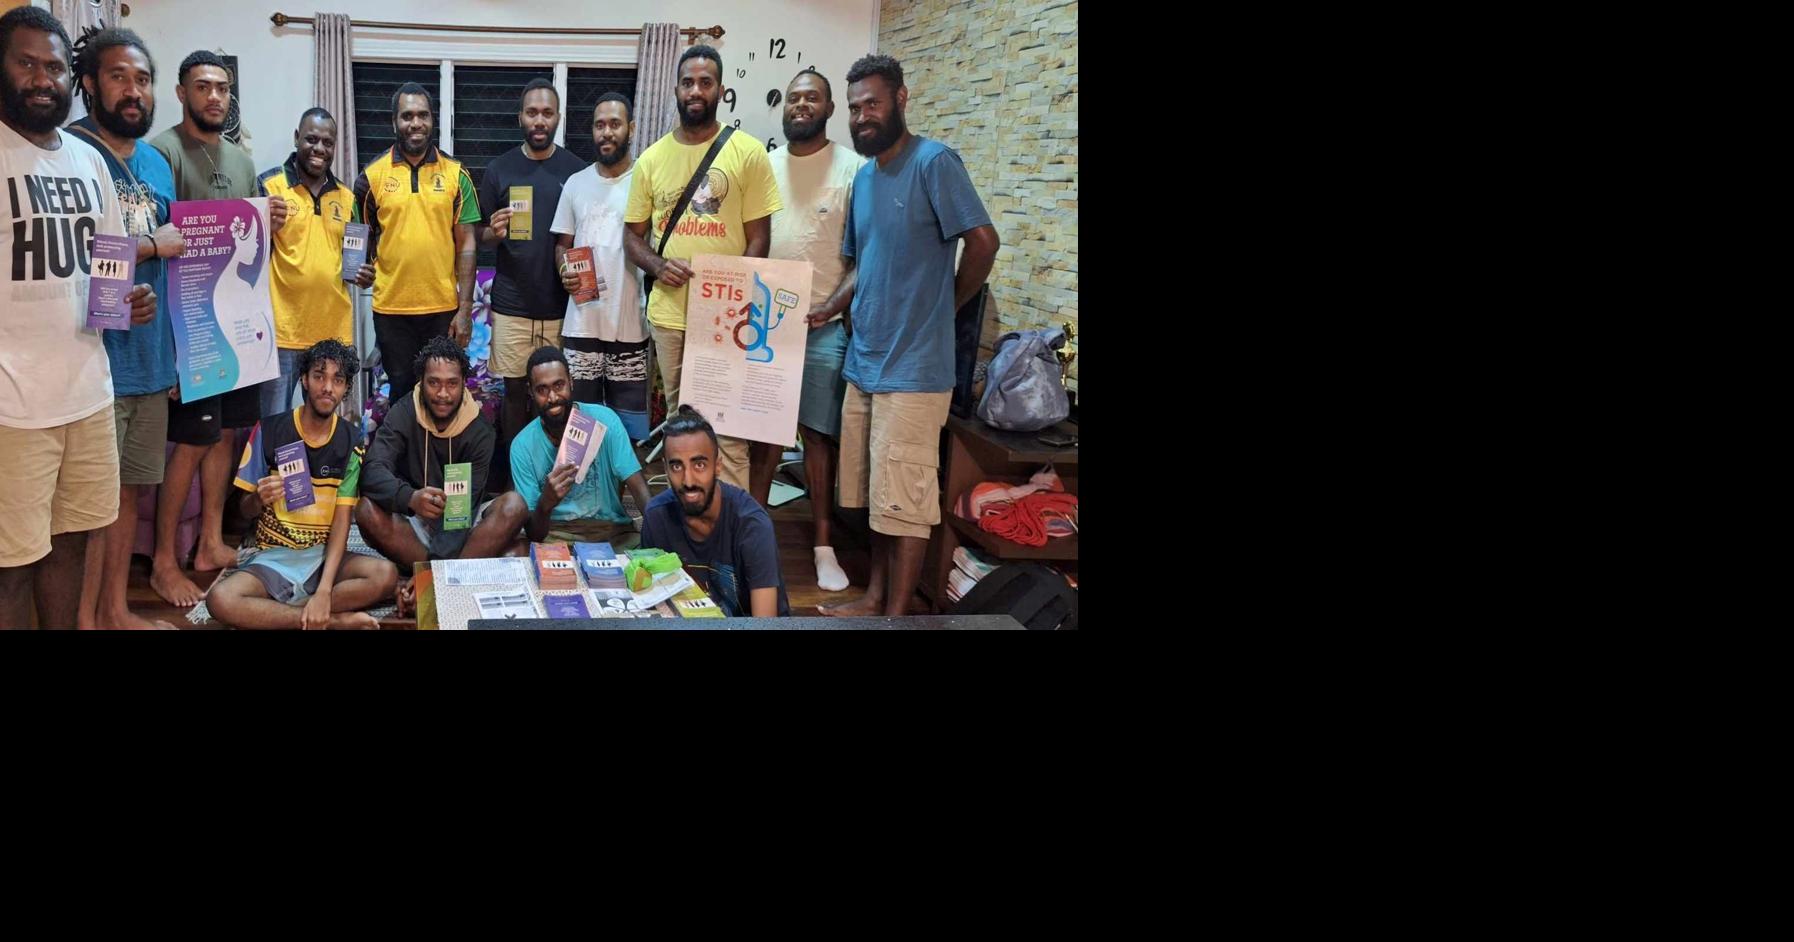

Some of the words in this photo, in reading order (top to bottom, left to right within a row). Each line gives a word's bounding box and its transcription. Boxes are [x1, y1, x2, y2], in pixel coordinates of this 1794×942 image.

[770, 38, 786, 59] 12
[736, 68, 746, 78] 10
[723, 88, 737, 113] 9
[766, 137, 778, 153] 6
[7, 177, 21, 219] I
[24, 174, 92, 215] NEED
[182, 216, 199, 226] ARE
[199, 215, 217, 224] YOU
[659, 216, 727, 238] oblems
[181, 225, 225, 236] PREGNANT
[193, 237, 214, 247] JUST
[200, 248, 206, 257] A
[207, 246, 231, 256] BABY?
[702, 282, 743, 302] STIs
[778, 292, 796, 305] SAFE
